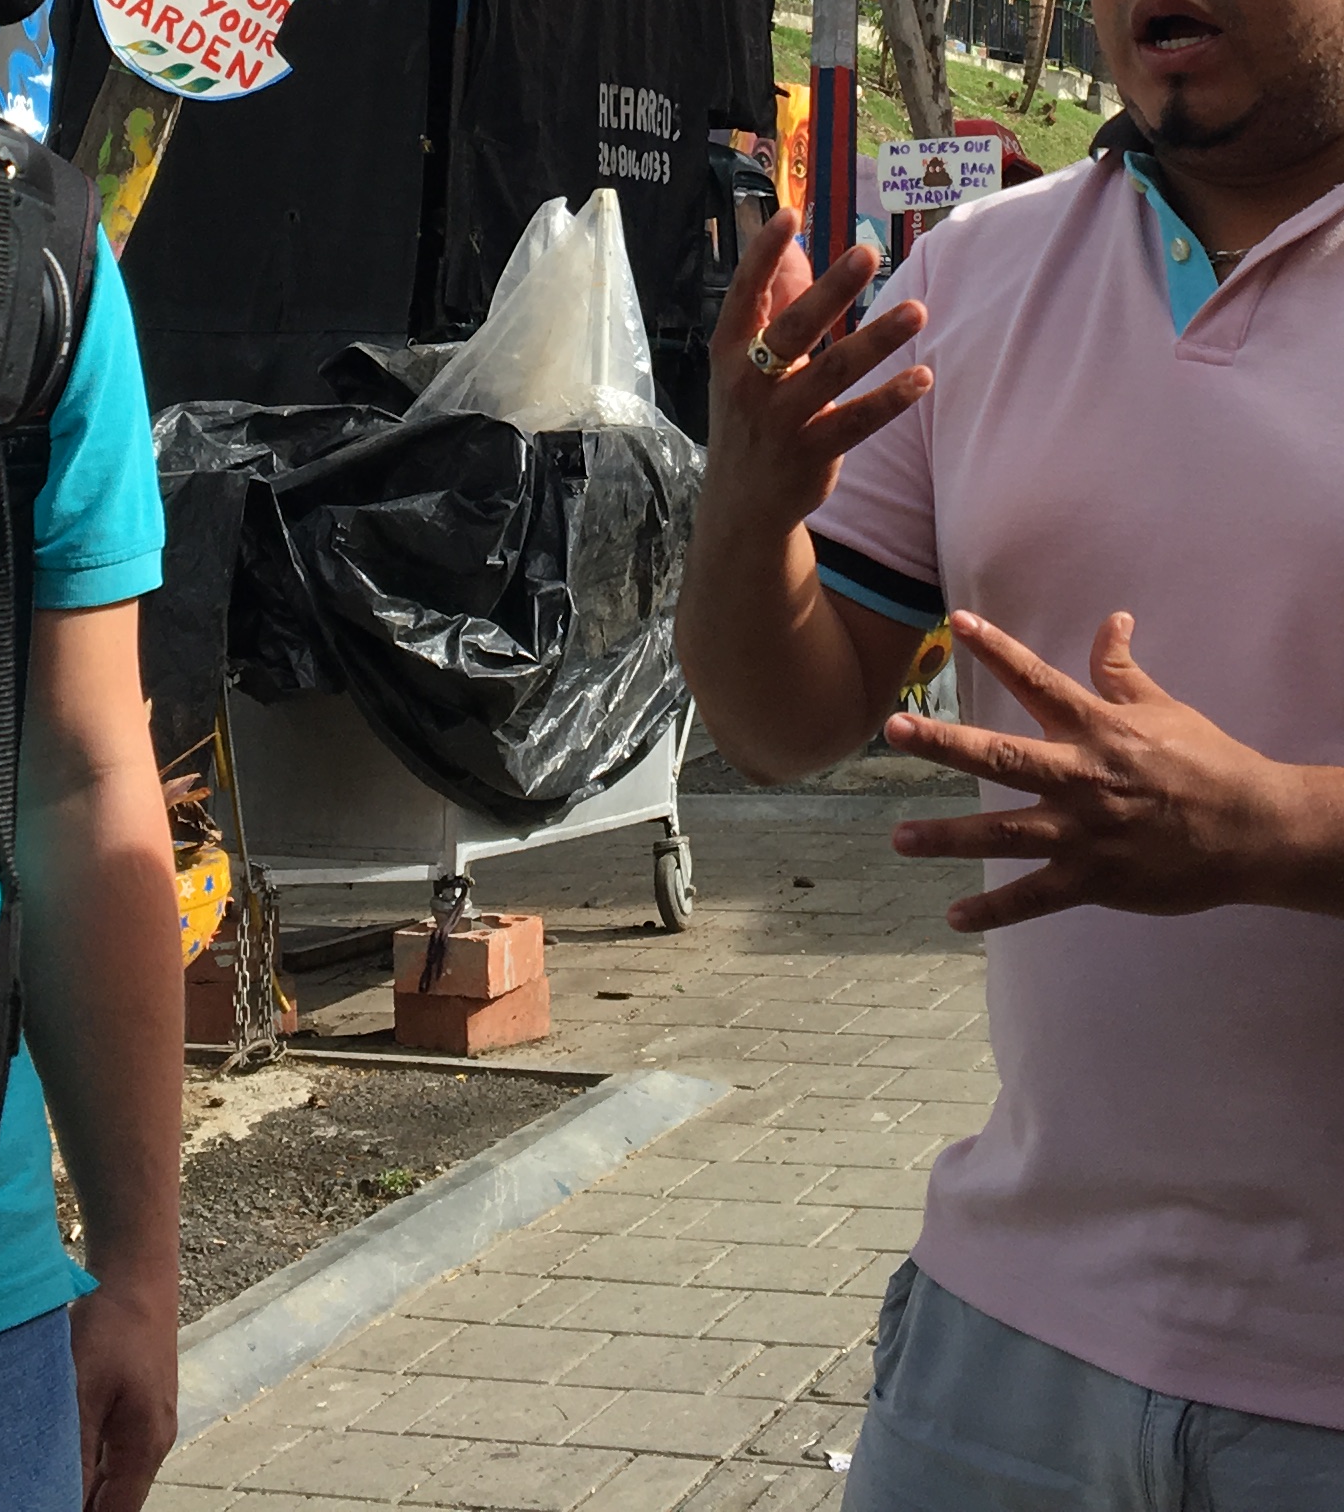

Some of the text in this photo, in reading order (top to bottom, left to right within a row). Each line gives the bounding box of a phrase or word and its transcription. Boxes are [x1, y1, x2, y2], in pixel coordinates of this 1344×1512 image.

[889, 144, 911, 156] NO
[963, 138, 992, 153] QUE
[598, 141, 671, 185] 3208140133
[890, 162, 996, 177] LA HAGA
[882, 176, 988, 192] PARTE DEL
